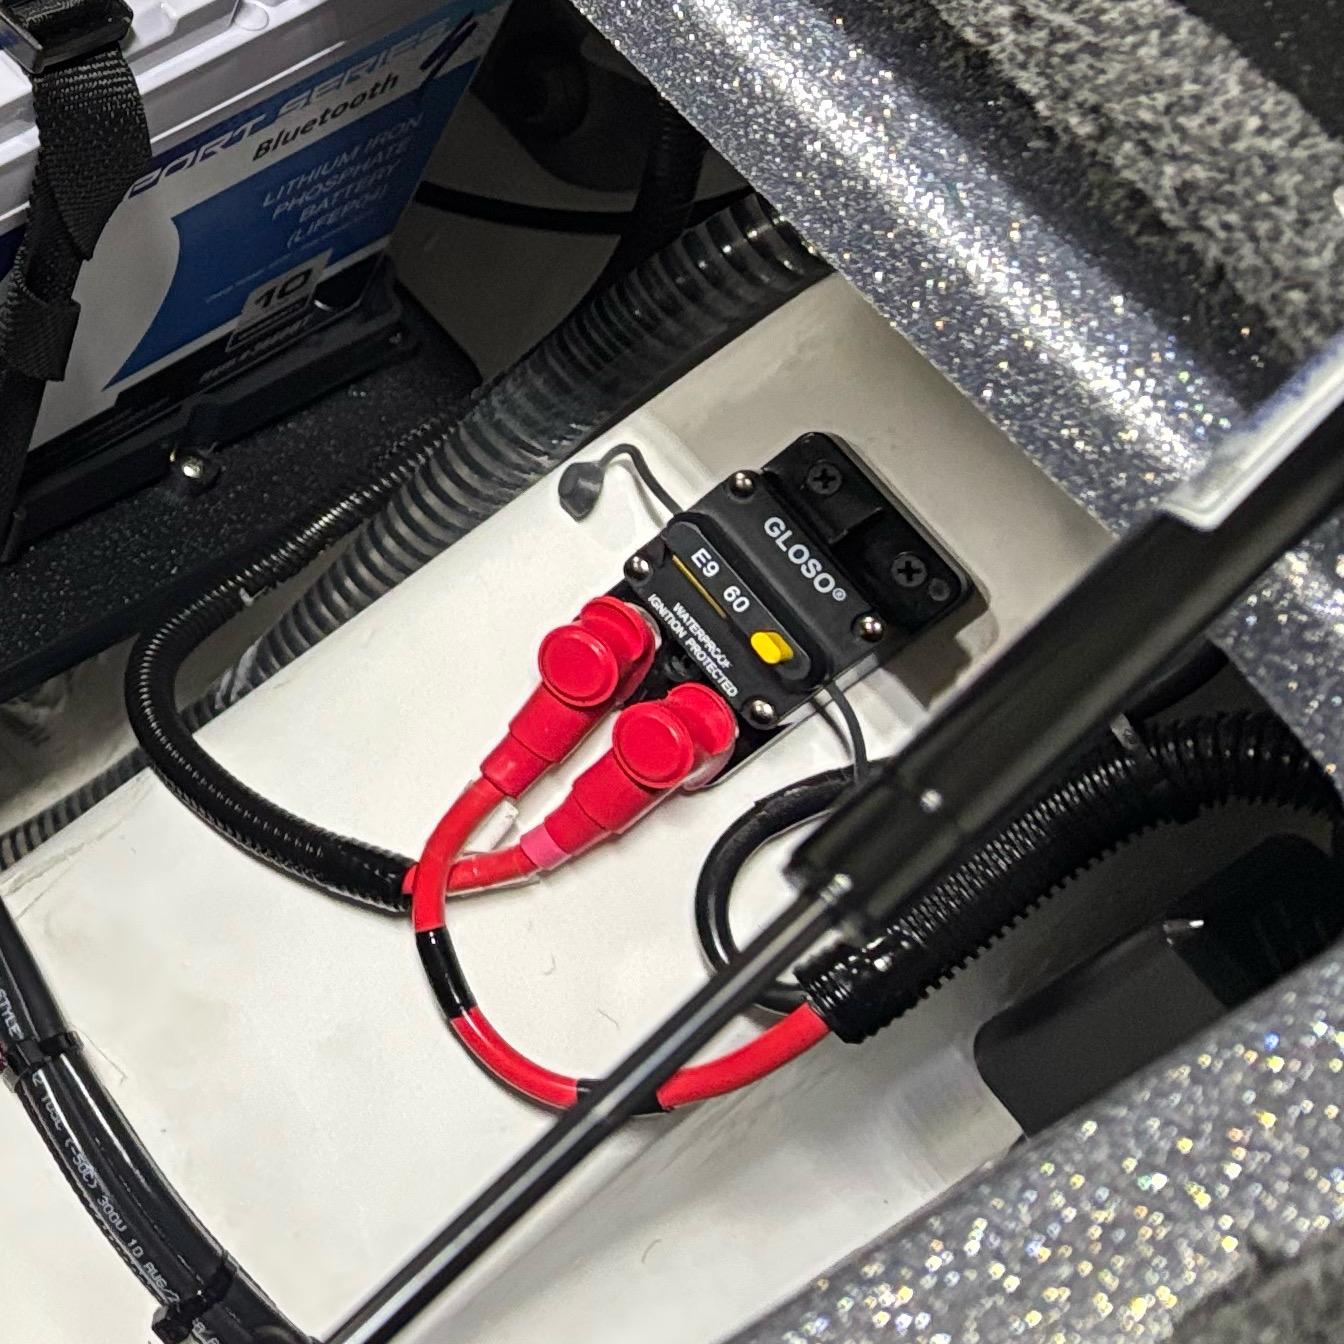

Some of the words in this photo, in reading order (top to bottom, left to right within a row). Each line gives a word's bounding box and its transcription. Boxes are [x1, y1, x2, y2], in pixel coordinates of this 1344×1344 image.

[252, 72, 400, 162] Bluetooth
[125, 115, 266, 200] PORT
[263, 144, 362, 208] LITHIUM
[691, 547, 720, 578] E9
[723, 585, 750, 613] 60
[648, 594, 685, 639] IGNITION
[684, 637, 739, 698] PROTECTED
[672, 601, 733, 669] WATERPROOF
[127, 1238, 144, 1258] 10
